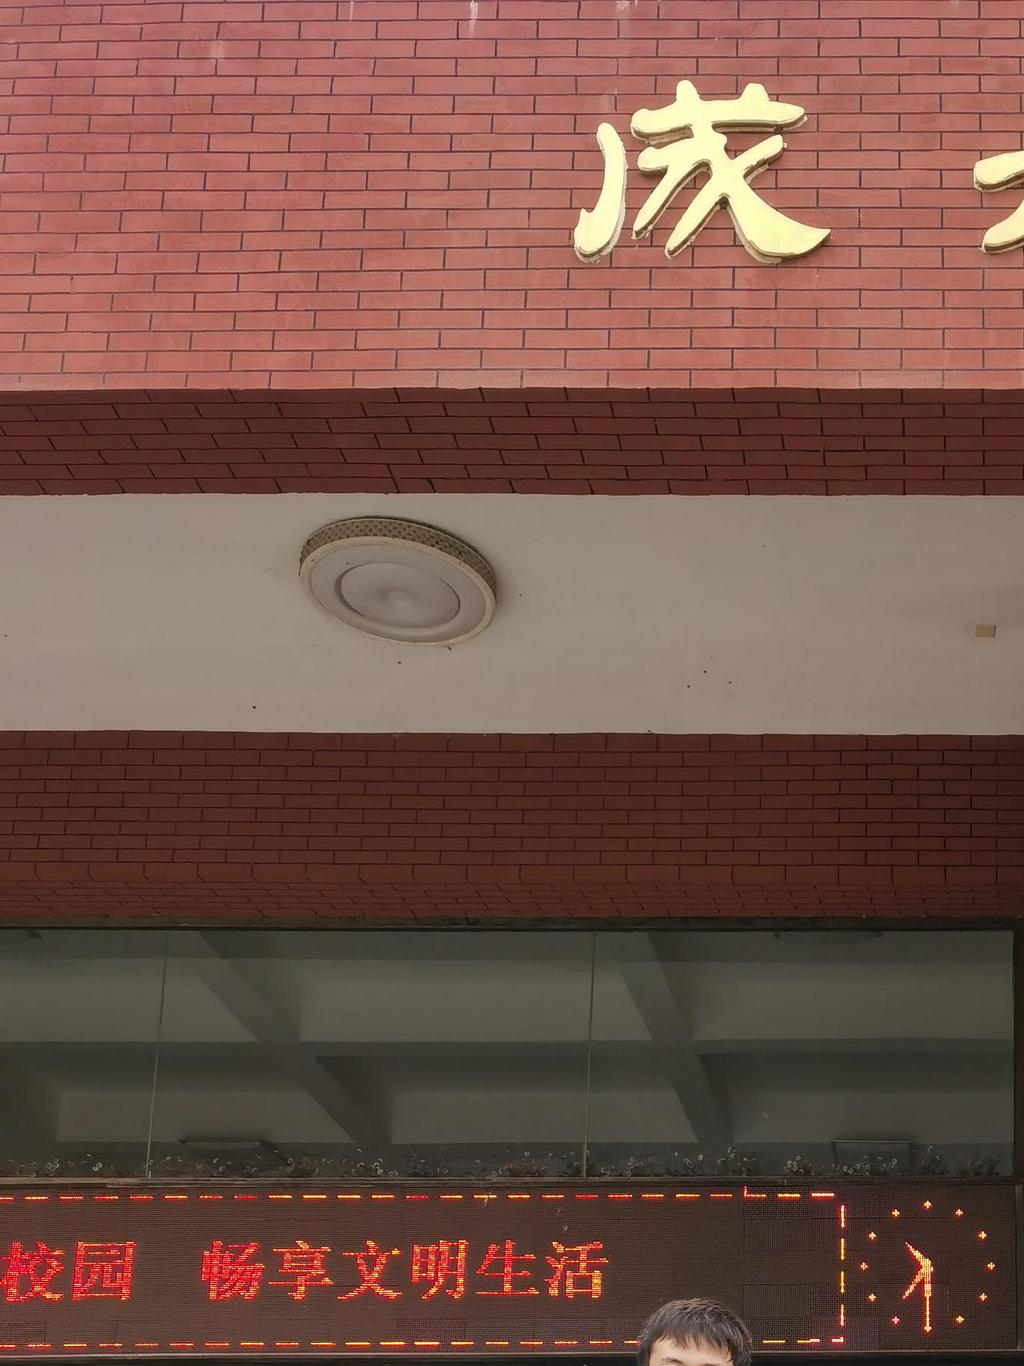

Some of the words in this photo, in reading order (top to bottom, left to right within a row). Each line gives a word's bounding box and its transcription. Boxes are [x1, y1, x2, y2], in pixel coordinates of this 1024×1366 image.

[0, 1239, 137, 1303] 校园
[201, 1238, 609, 1301] 畅享文明生活
